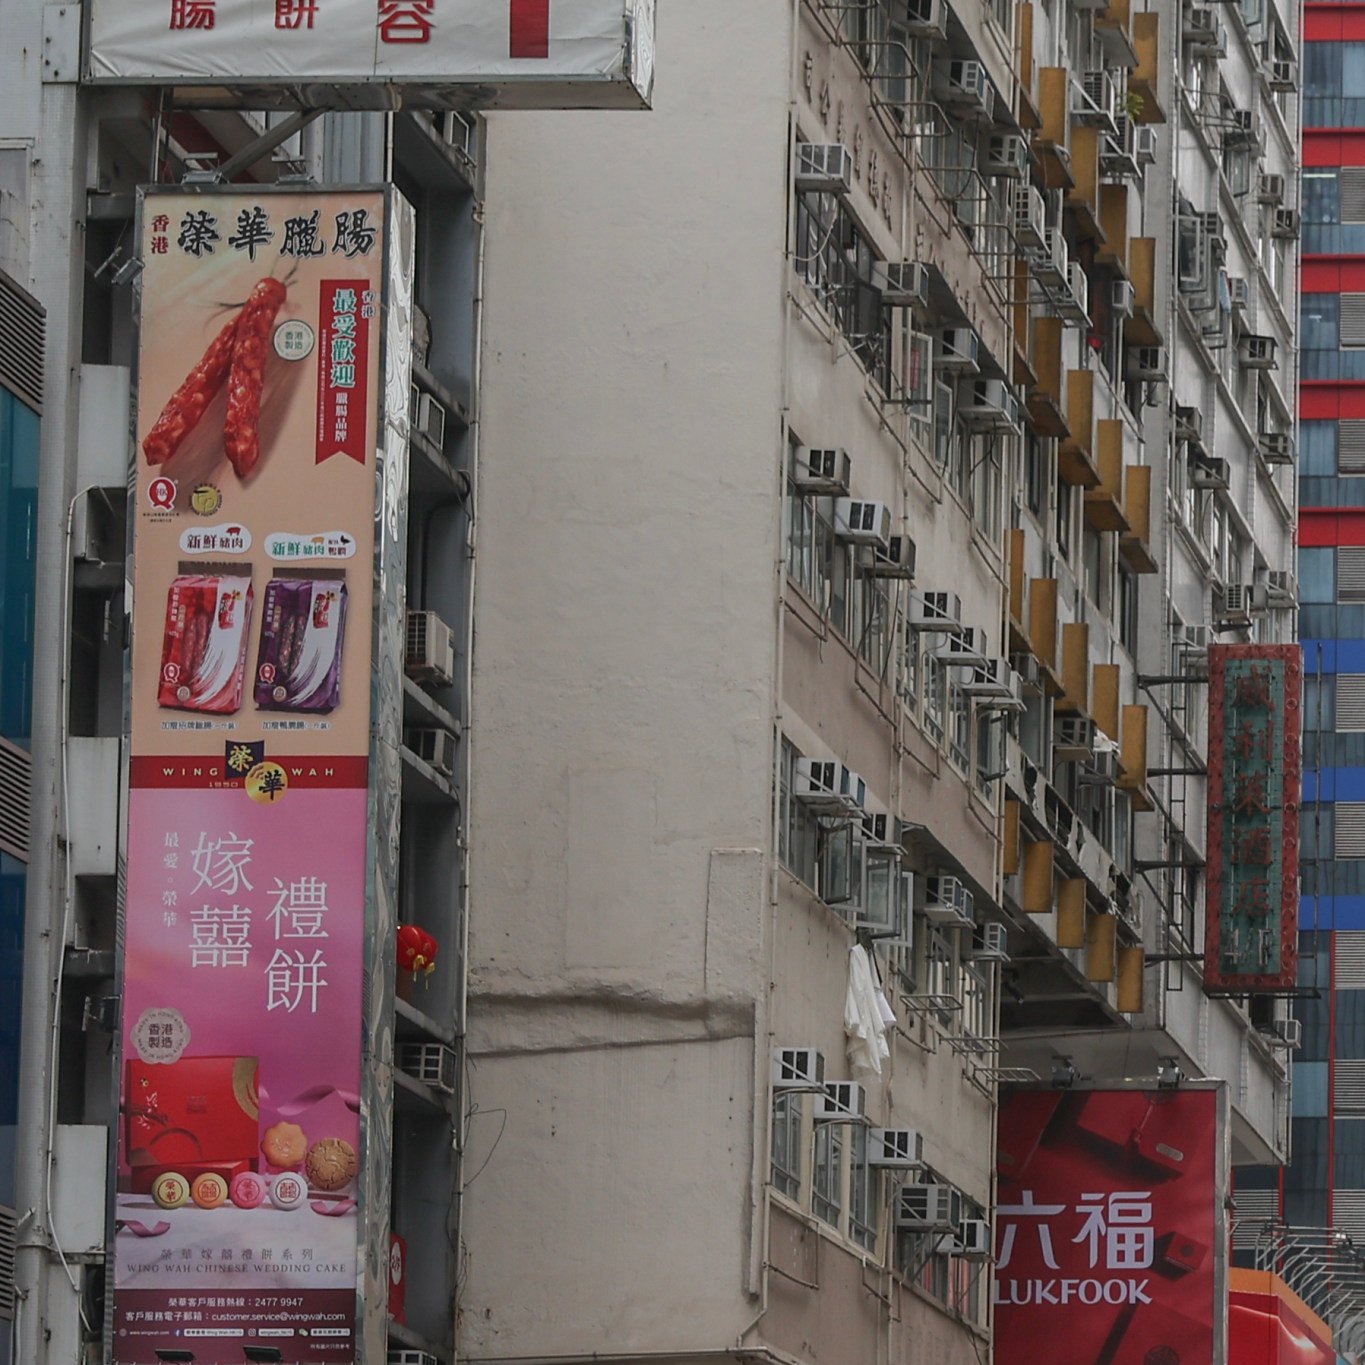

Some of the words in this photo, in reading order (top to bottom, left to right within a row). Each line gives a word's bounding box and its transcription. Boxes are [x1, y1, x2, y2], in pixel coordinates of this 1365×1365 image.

[151, 214, 170, 255] 香港
[361, 289, 377, 319] 香港
[330, 288, 358, 389] 最受歡迎
[162, 768, 219, 777] WING
[227, 745, 254, 773] 榮
[258, 769, 286, 801] 華
[291, 767, 335, 777] WAH
[263, 876, 330, 1014] 禮餅
[1227, 928, 1273, 967] 4/F
[148, 1023, 174, 1037] 香港
[148, 1036, 173, 1049] 製造
[995, 1189, 1156, 1271] 六福
[127, 1263, 160, 1273] WING
[165, 1263, 191, 1273] WAH
[196, 1263, 249, 1273] CHINESE
[253, 1263, 311, 1273] WEDDING
[315, 1263, 347, 1273] CAKE
[255, 1297, 279, 1307] 2477
[280, 1297, 304, 1307] 9947
[993, 1278, 1153, 1306] LUKFOOK
